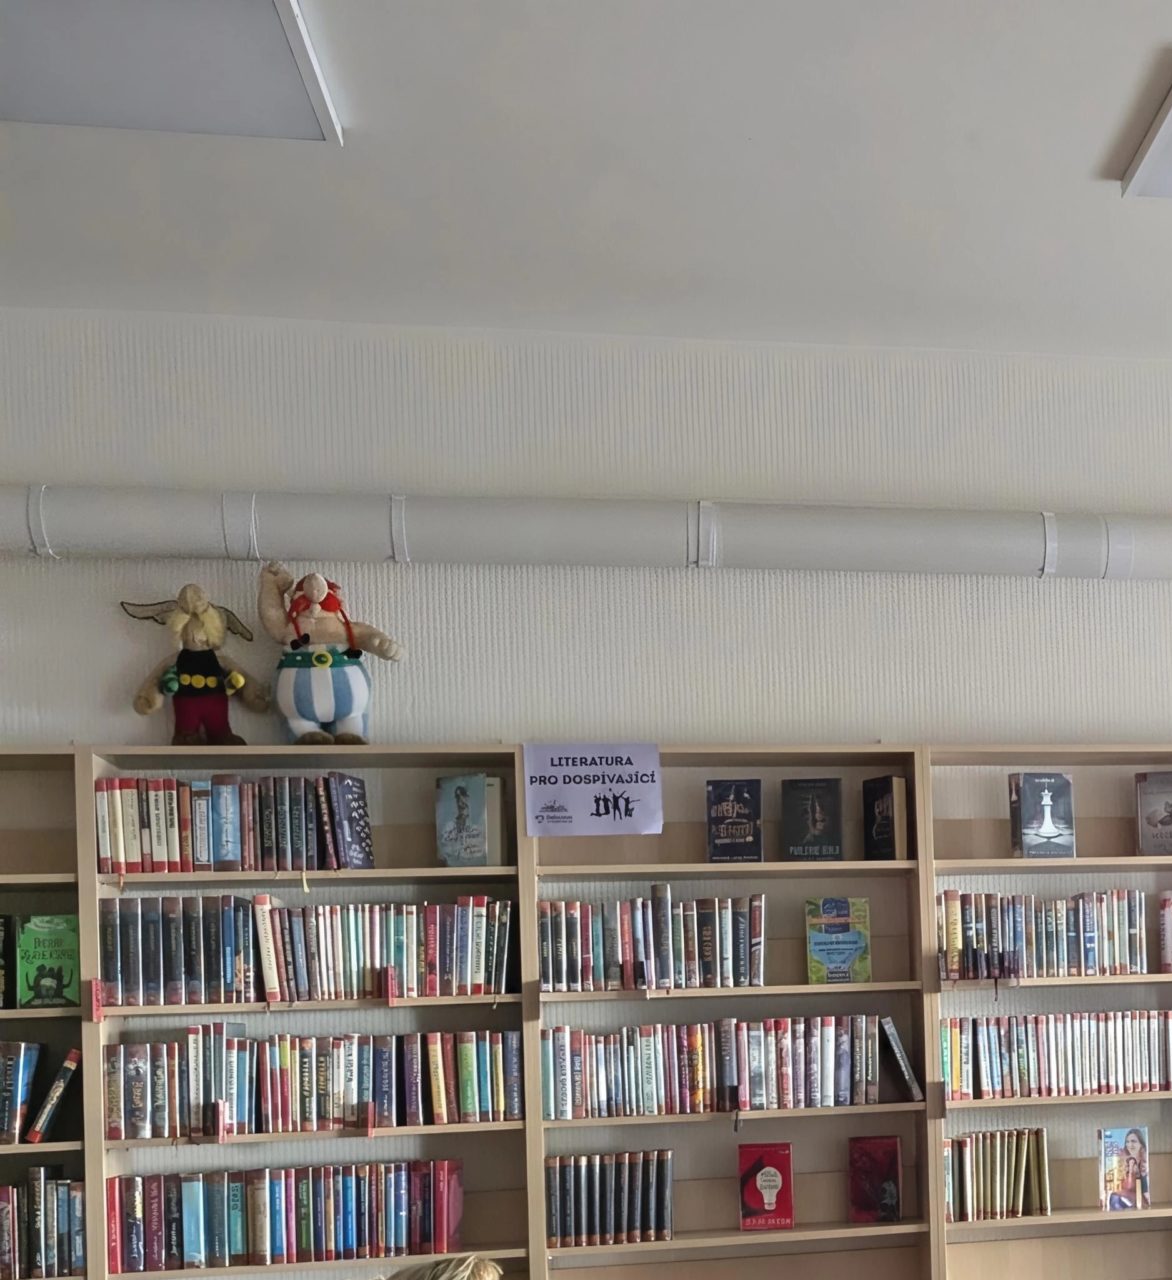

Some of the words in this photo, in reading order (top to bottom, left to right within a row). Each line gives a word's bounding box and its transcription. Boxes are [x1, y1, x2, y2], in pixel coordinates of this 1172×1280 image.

[550, 756, 634, 767] LITERATURA
[529, 775, 558, 786] PRO
[563, 770, 656, 785] DOSPÍVAJÍCÍ
